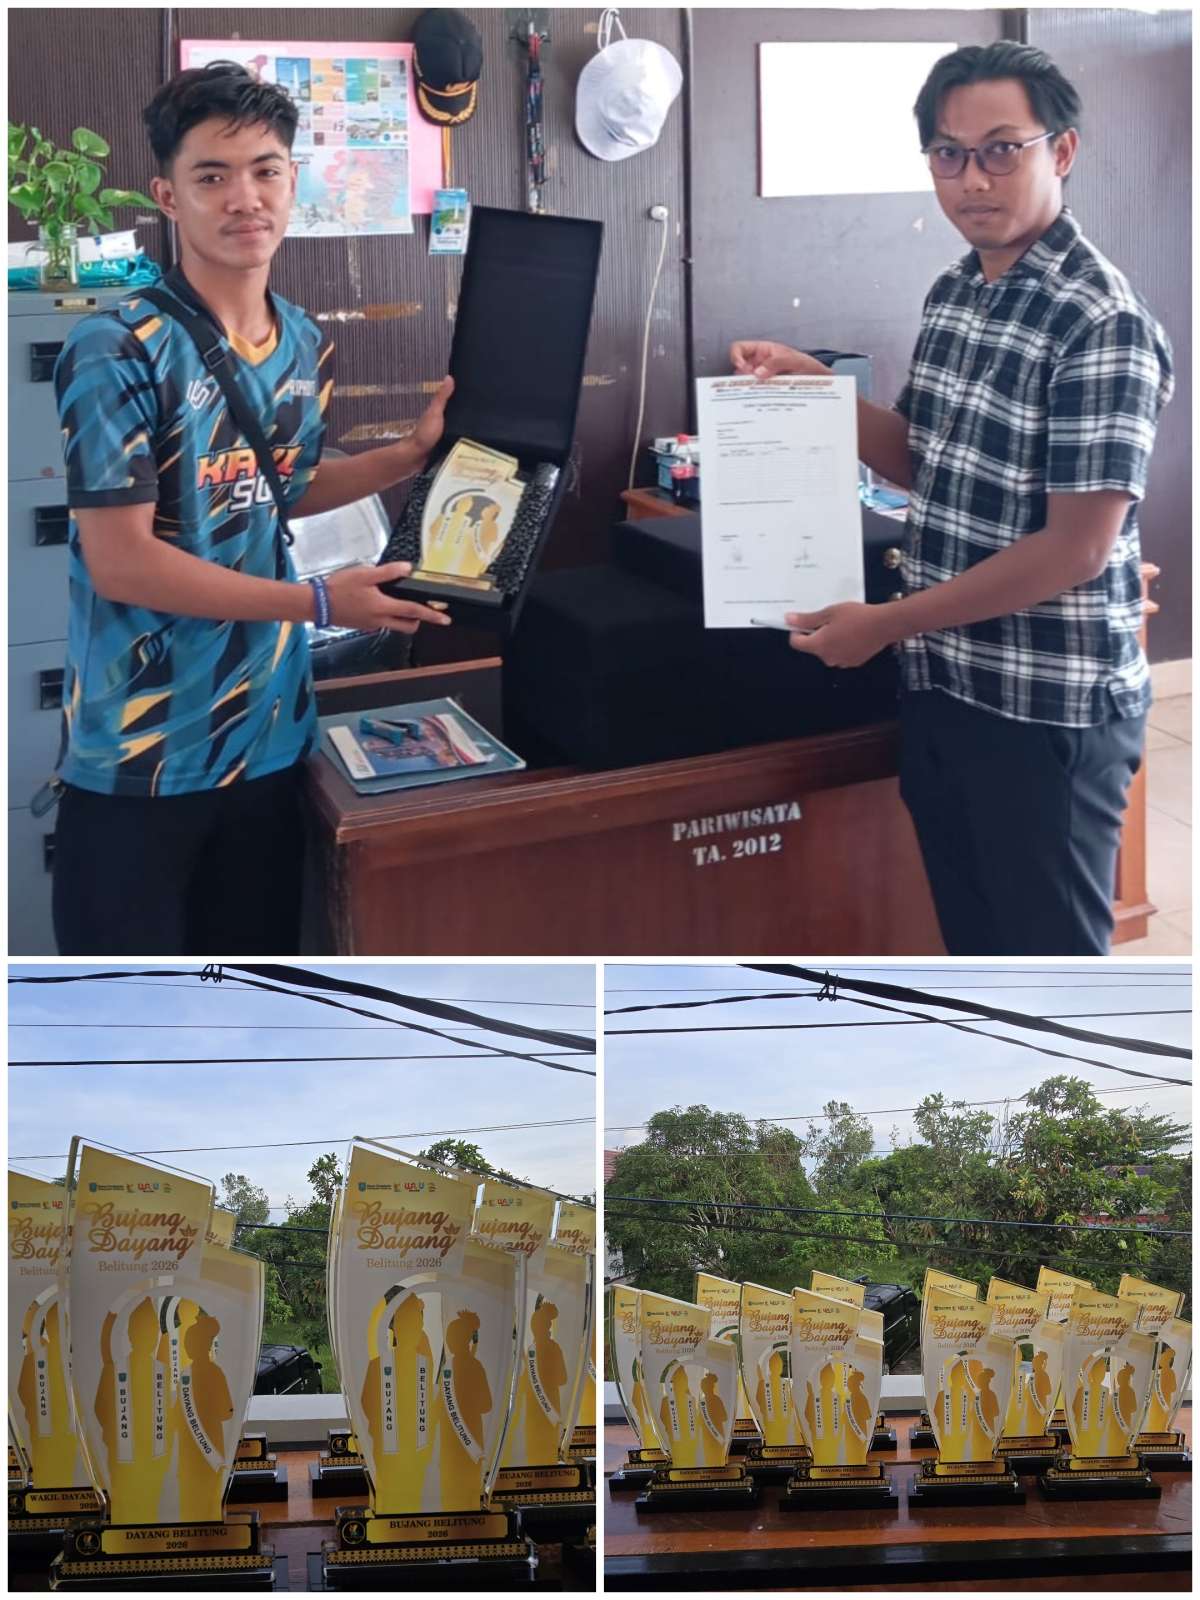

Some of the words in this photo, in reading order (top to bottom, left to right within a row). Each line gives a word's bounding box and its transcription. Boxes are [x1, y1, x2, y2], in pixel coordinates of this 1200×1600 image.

[672, 802, 802, 842] PARIWISATA
[693, 845, 727, 866] TA.
[732, 833, 782, 858] 2012
[79, 1202, 186, 1236] Bujang
[352, 1200, 450, 1234] Bujang
[479, 1219, 535, 1241] ujang
[88, 1227, 195, 1261] Dayang
[357, 1225, 456, 1258] Dayang
[98, 1262, 149, 1273] Belitung
[151, 1261, 180, 1272] 2026
[367, 1258, 414, 1270] Belitung
[416, 1257, 443, 1268] 2026
[645, 1320, 697, 1337] Bujang
[799, 1318, 848, 1333] Bujang
[932, 1315, 980, 1331] Bujang
[649, 1332, 704, 1348] Dayang
[799, 1331, 853, 1345] Dayang
[933, 1328, 985, 1343] Dayang
[119, 1388, 129, 1439] BUJANG
[385, 1382, 393, 1431] BUJANG
[443, 1381, 455, 1412] DAYANG
[450, 1411, 472, 1446] BELITUNG
[182, 1387, 195, 1418] DAYANG
[190, 1418, 213, 1455] BELITUNG
[499, 1471, 533, 1480] BUJANG
[534, 1469, 576, 1478] BELITUNG
[389, 1519, 432, 1529] BUJANG
[433, 1517, 486, 1527] BELITUNG
[126, 1529, 170, 1540] DAYANG
[172, 1527, 229, 1538] BELITUNG
[427, 1529, 449, 1538] 2026
[165, 1541, 189, 1550] 2026
